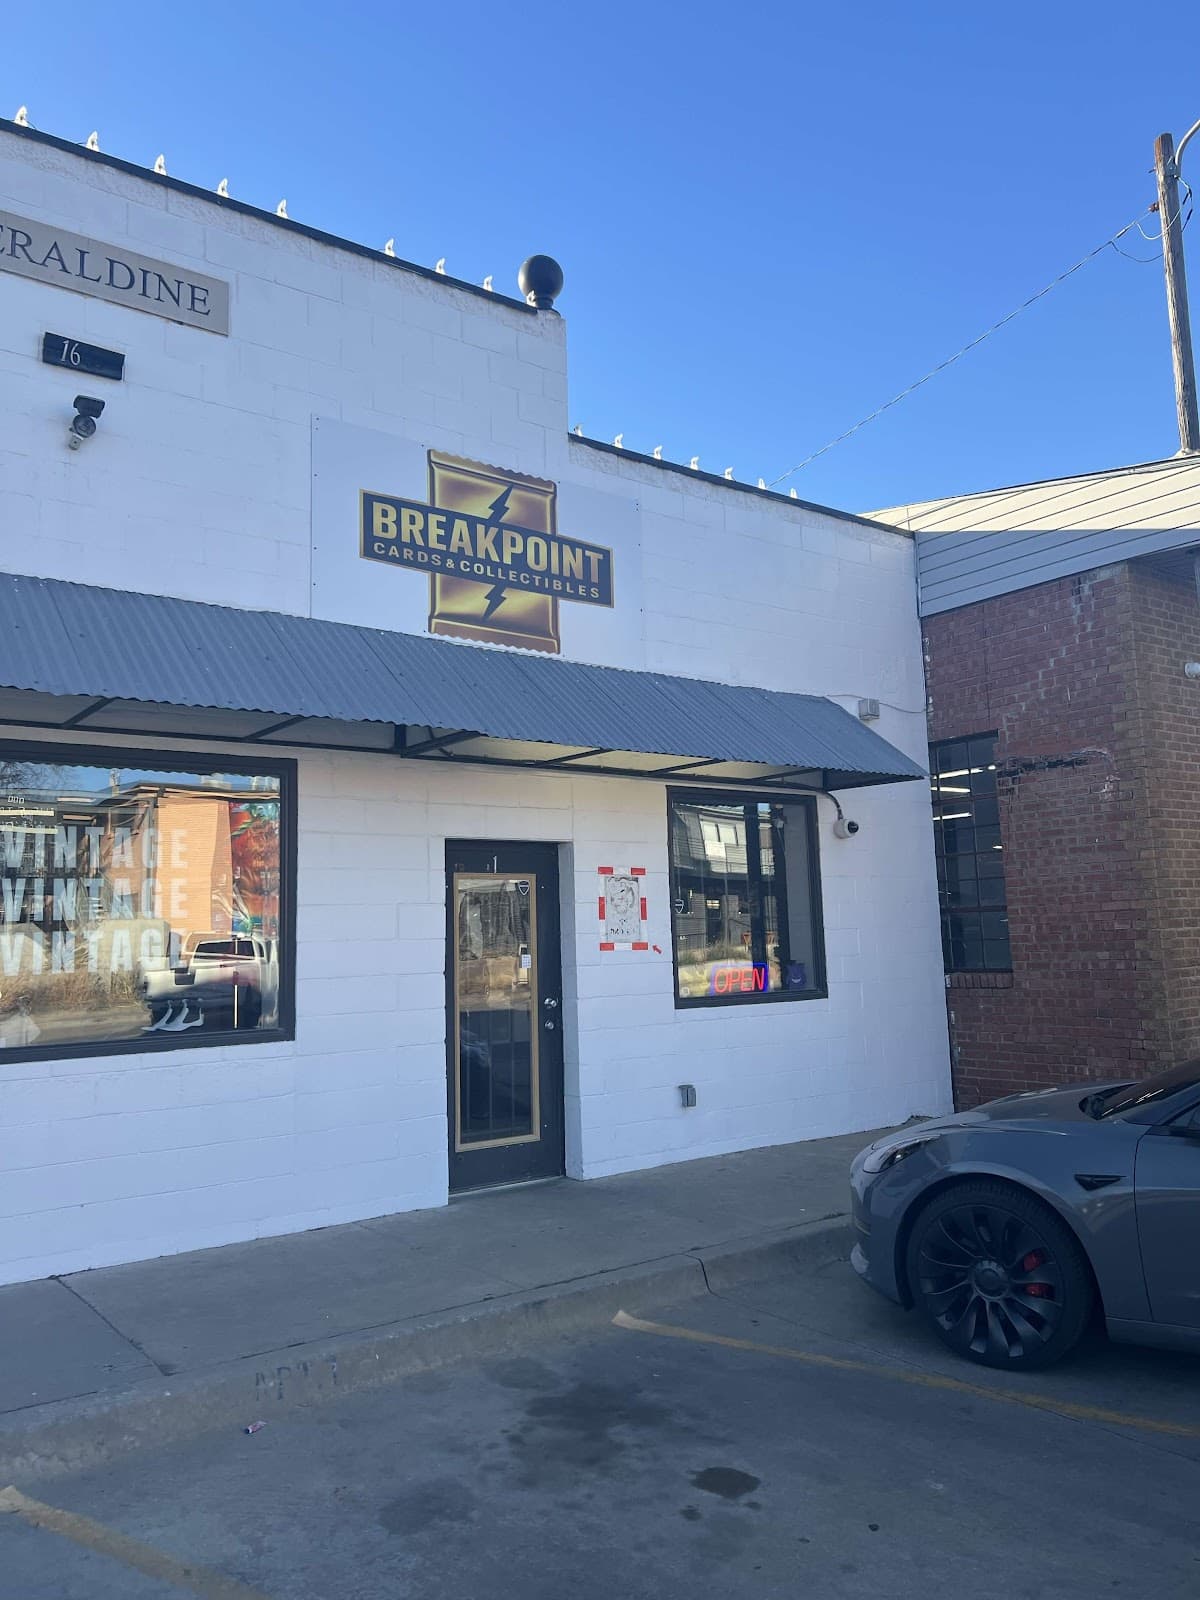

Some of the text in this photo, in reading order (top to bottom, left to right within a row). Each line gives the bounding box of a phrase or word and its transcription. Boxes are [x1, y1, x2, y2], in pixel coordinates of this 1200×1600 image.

[0, 225, 211, 316] RALDINE
[60, 339, 81, 366] 16
[372, 502, 604, 583] BREAKPOINT
[373, 542, 442, 566] CARDS
[459, 560, 600, 598] COLLECTIBLES
[3, 826, 188, 869] VINTAGE
[2, 877, 188, 922] VINTAGE
[714, 967, 765, 993] OPEN
